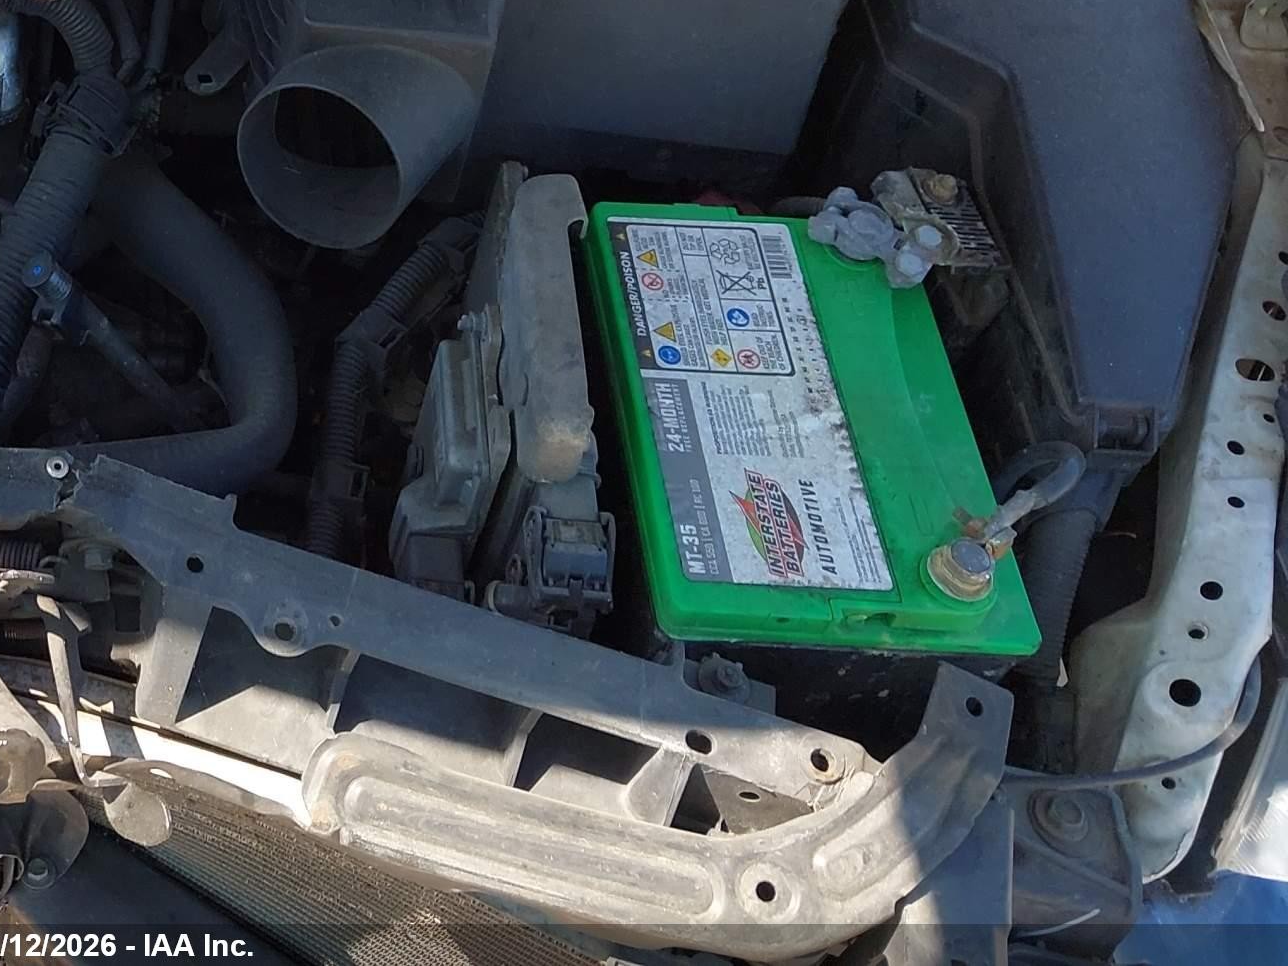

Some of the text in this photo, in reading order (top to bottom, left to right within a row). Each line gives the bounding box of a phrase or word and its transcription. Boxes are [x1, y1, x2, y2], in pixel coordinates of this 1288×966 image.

[620, 251, 647, 336] DANGER/POISON
[656, 382, 685, 451] 24-MONTH
[670, 383, 688, 432] REPLACEMENT
[681, 523, 706, 573] MT-35
[748, 473, 784, 574] INTERSTATE
[764, 481, 800, 572] BATTERIES
[799, 478, 837, 574] AUTOMOTIVE
